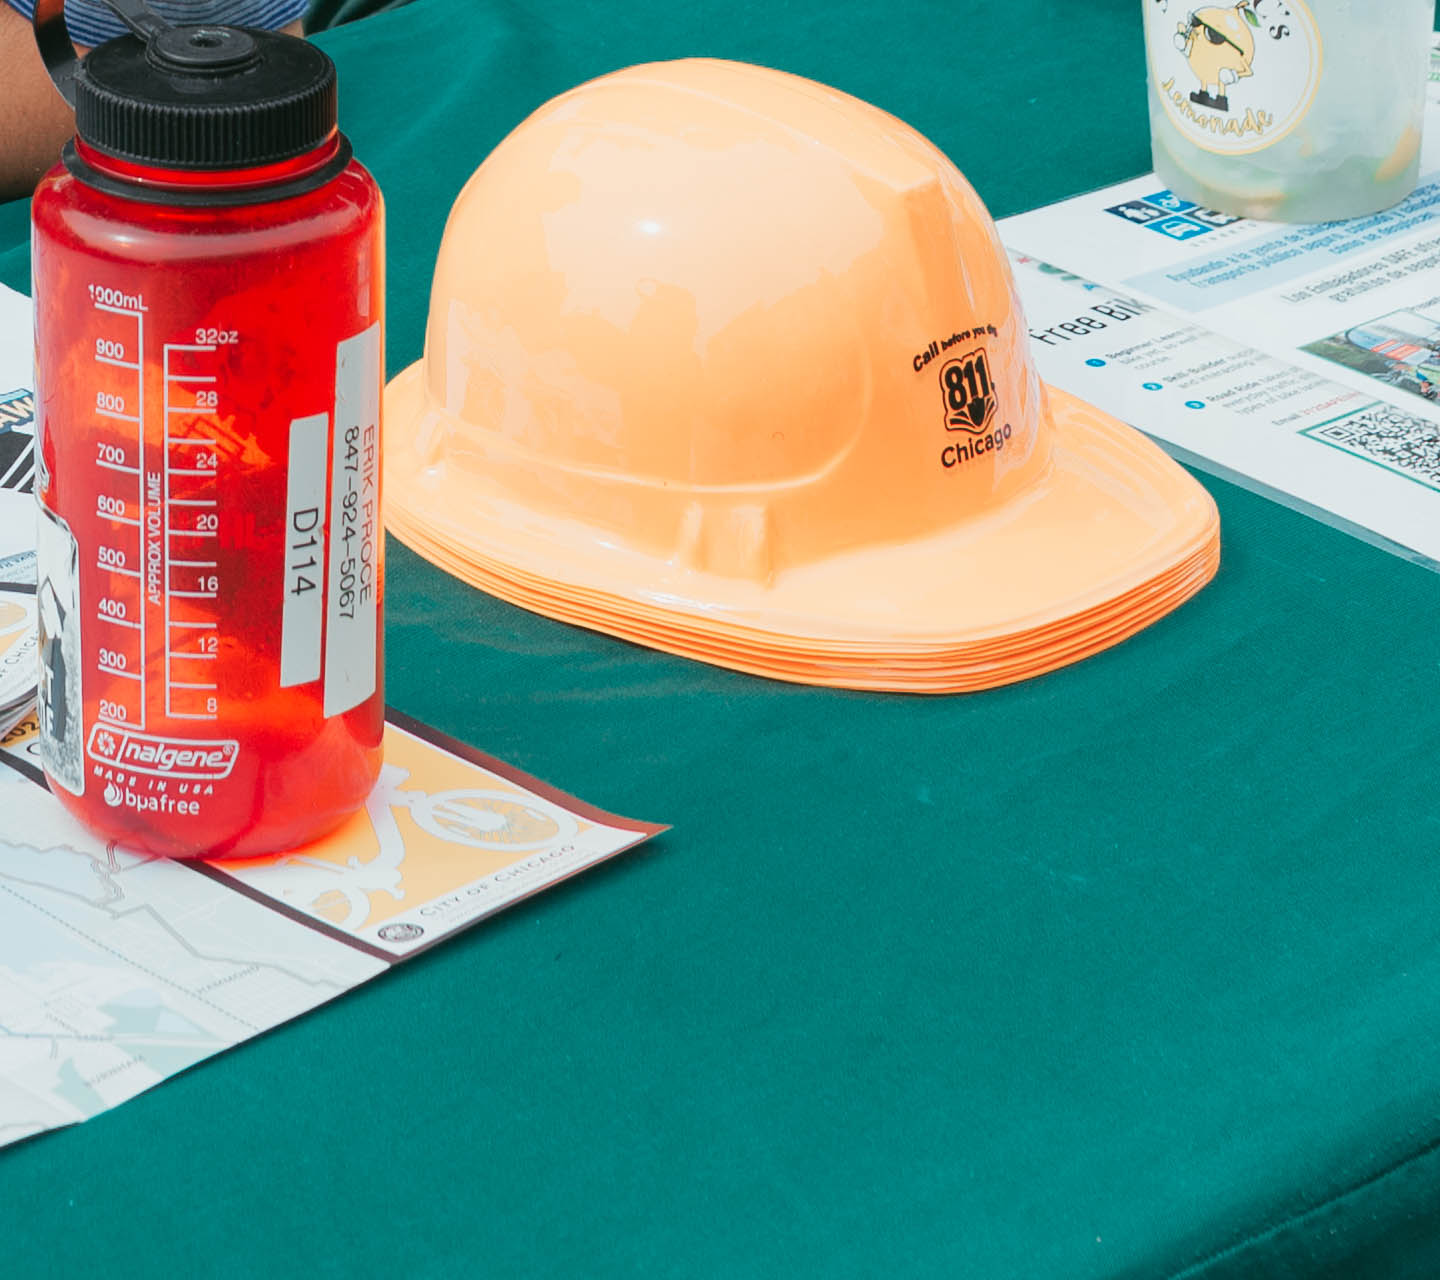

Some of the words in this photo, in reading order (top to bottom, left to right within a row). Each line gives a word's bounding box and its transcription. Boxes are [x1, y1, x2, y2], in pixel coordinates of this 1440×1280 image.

[1162, 77, 1273, 138] Lemonade
[195, 328, 238, 345] 32oz
[1030, 316, 1108, 346] Free
[96, 338, 124, 359] 900
[913, 341, 939, 372] Call
[941, 329, 970, 351] before
[972, 325, 985, 339] you
[945, 354, 990, 410] 811
[96, 392, 124, 413] 800
[196, 391, 218, 407] 28
[97, 442, 125, 464] 700
[941, 423, 1012, 468] Chicago
[196, 453, 218, 469] 24
[362, 424, 375, 495] ERIK
[97, 495, 125, 516] 600
[147, 471, 161, 530] VOLUME
[196, 515, 218, 530] 20
[339, 425, 359, 619] 847-924-5067
[98, 547, 125, 568] 500
[291, 507, 319, 596] D114
[359, 499, 373, 605] PROCE
[148, 533, 162, 606] APPROX
[197, 576, 219, 592] 16
[98, 597, 126, 619] 400
[197, 637, 219, 653] 12
[99, 649, 127, 670] 300
[99, 699, 127, 722] 200
[206, 697, 218, 713] 8
[125, 742, 224, 773] nalgene
[94, 765, 138, 786] MADE
[148, 779, 167, 792] IN
[179, 783, 214, 795] USA
[125, 788, 200, 816] bpafree
